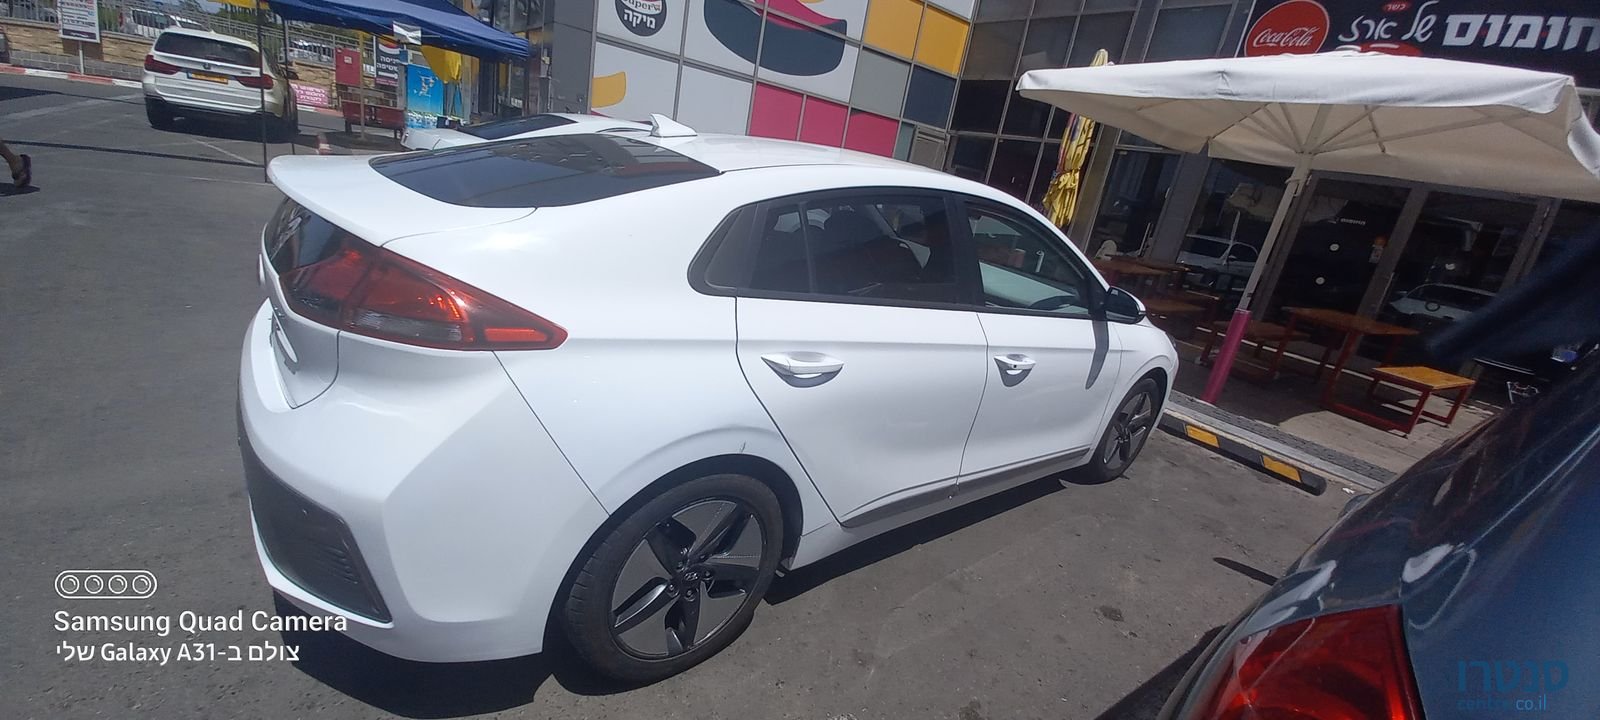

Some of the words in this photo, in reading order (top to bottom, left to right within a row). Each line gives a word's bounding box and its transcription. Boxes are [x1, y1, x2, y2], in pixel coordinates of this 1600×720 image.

[622, 0, 652, 11] uper
[1387, 3, 1406, 11] כשר
[623, 9, 656, 29] מיקה
[1338, 15, 1398, 41] ארז
[1401, 0, 1439, 42] של
[1442, 14, 1600, 52] חומוס
[380, 55, 400, 64] ניסה
